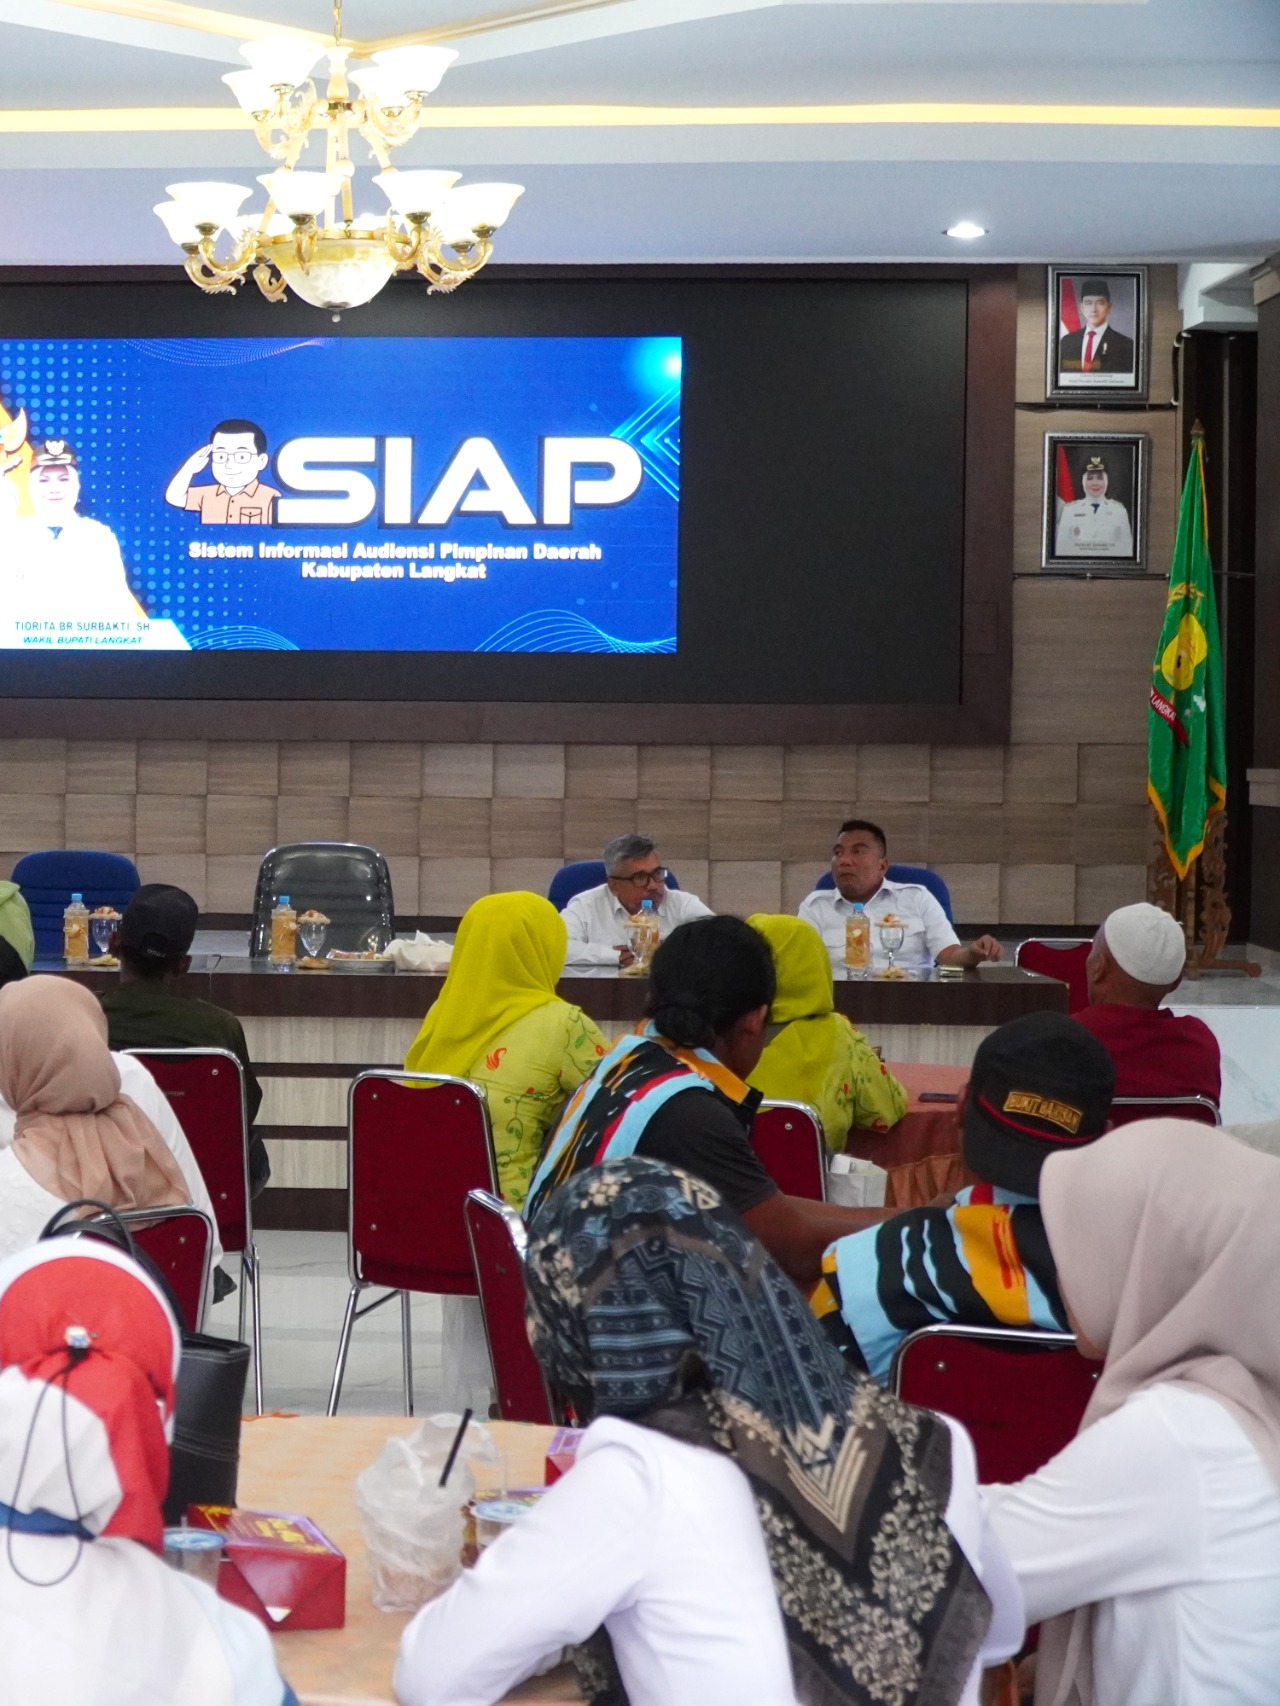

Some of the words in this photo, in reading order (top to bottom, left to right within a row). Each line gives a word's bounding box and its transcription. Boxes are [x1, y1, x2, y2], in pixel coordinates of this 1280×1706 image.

[276, 436, 643, 526] SIAP
[189, 542, 253, 560] Sistem
[259, 542, 348, 560] Informasi
[353, 543, 435, 561] Audiensi
[440, 543, 528, 563] Pimpinan
[533, 543, 602, 561] Daerah
[302, 562, 404, 581] Kabupaten
[409, 563, 487, 583] Langkat
[15, 622, 56, 632] TIORITA
[59, 622, 74, 632] BR
[136, 622, 151, 632] SH
[23, 636, 55, 645] WAKIL
[57, 636, 93, 645] BUPATI
[95, 636, 143, 645] LANGKAT
